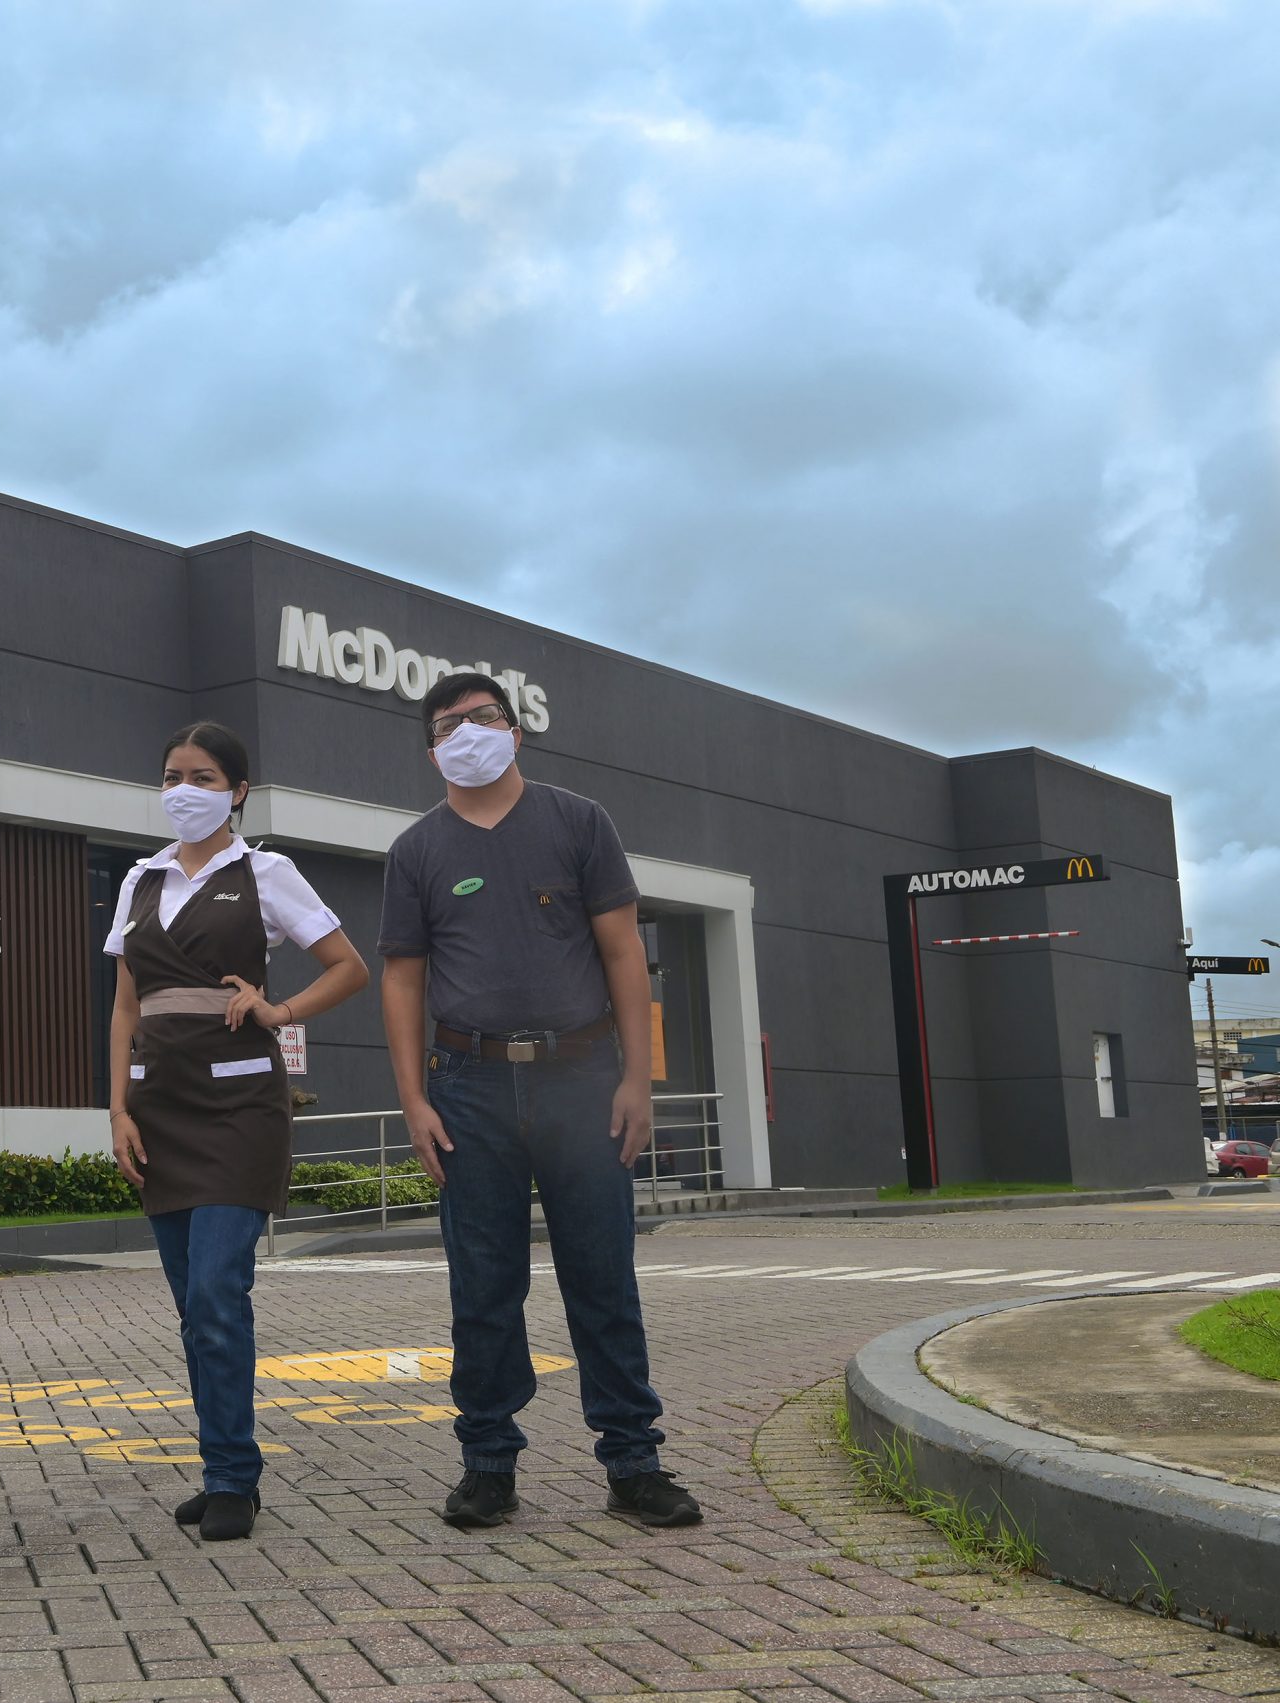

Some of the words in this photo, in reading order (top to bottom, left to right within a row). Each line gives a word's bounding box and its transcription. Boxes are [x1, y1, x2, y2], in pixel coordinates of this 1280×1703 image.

[277, 605, 550, 734] McDond's
[907, 865, 1025, 893] AUTOMAC
[1192, 957, 1219, 970] Aquí
